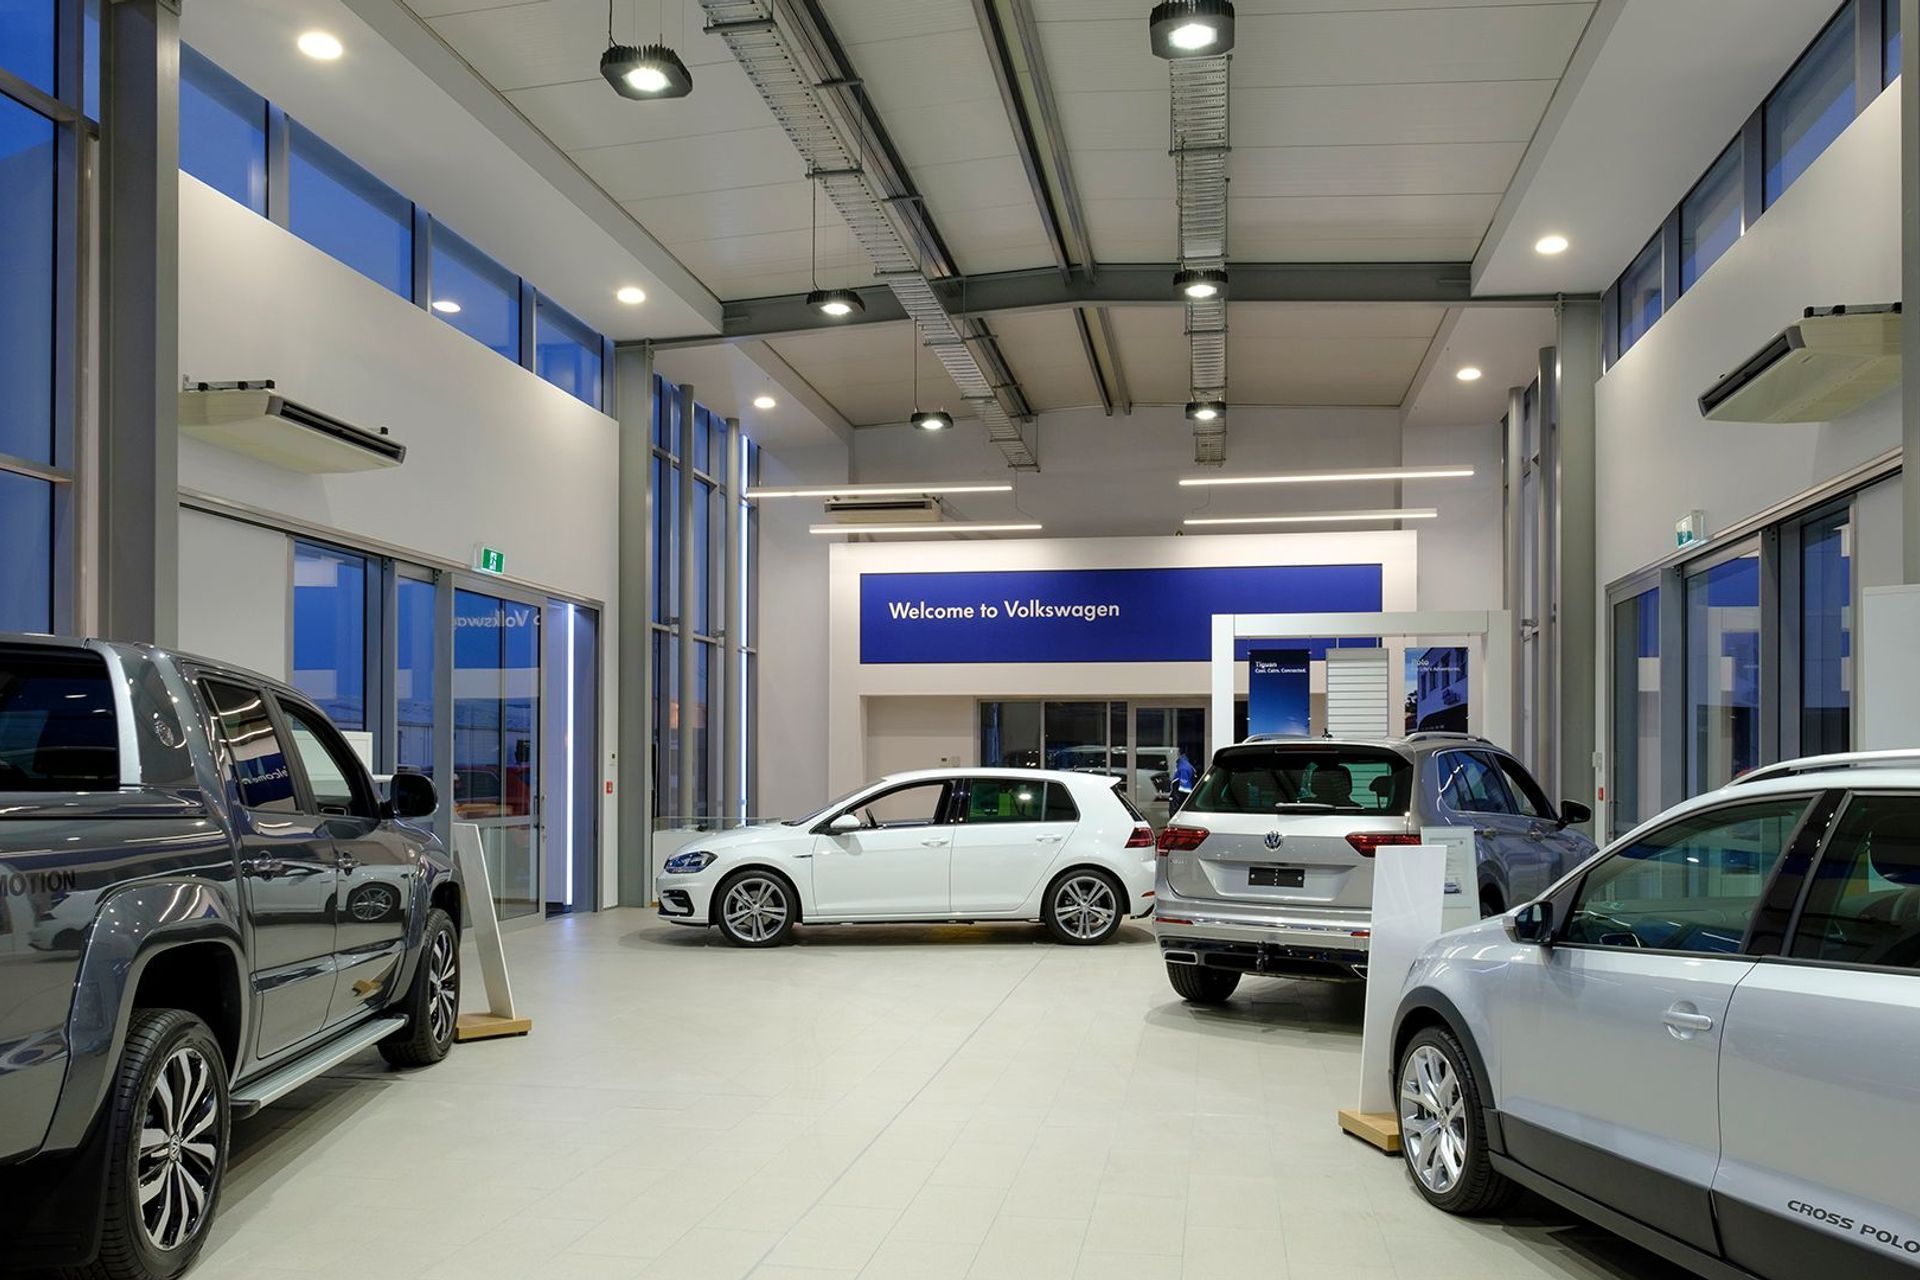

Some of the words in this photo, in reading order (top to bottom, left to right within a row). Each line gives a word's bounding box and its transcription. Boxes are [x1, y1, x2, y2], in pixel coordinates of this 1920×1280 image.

[888, 602, 975, 619] Welcome
[980, 603, 998, 618] to
[1004, 599, 1120, 621] Volkswagen
[1255, 661, 1278, 669] Tiguan
[1787, 1200, 1855, 1230] CROSS
[1860, 1224, 1920, 1254] POLO
